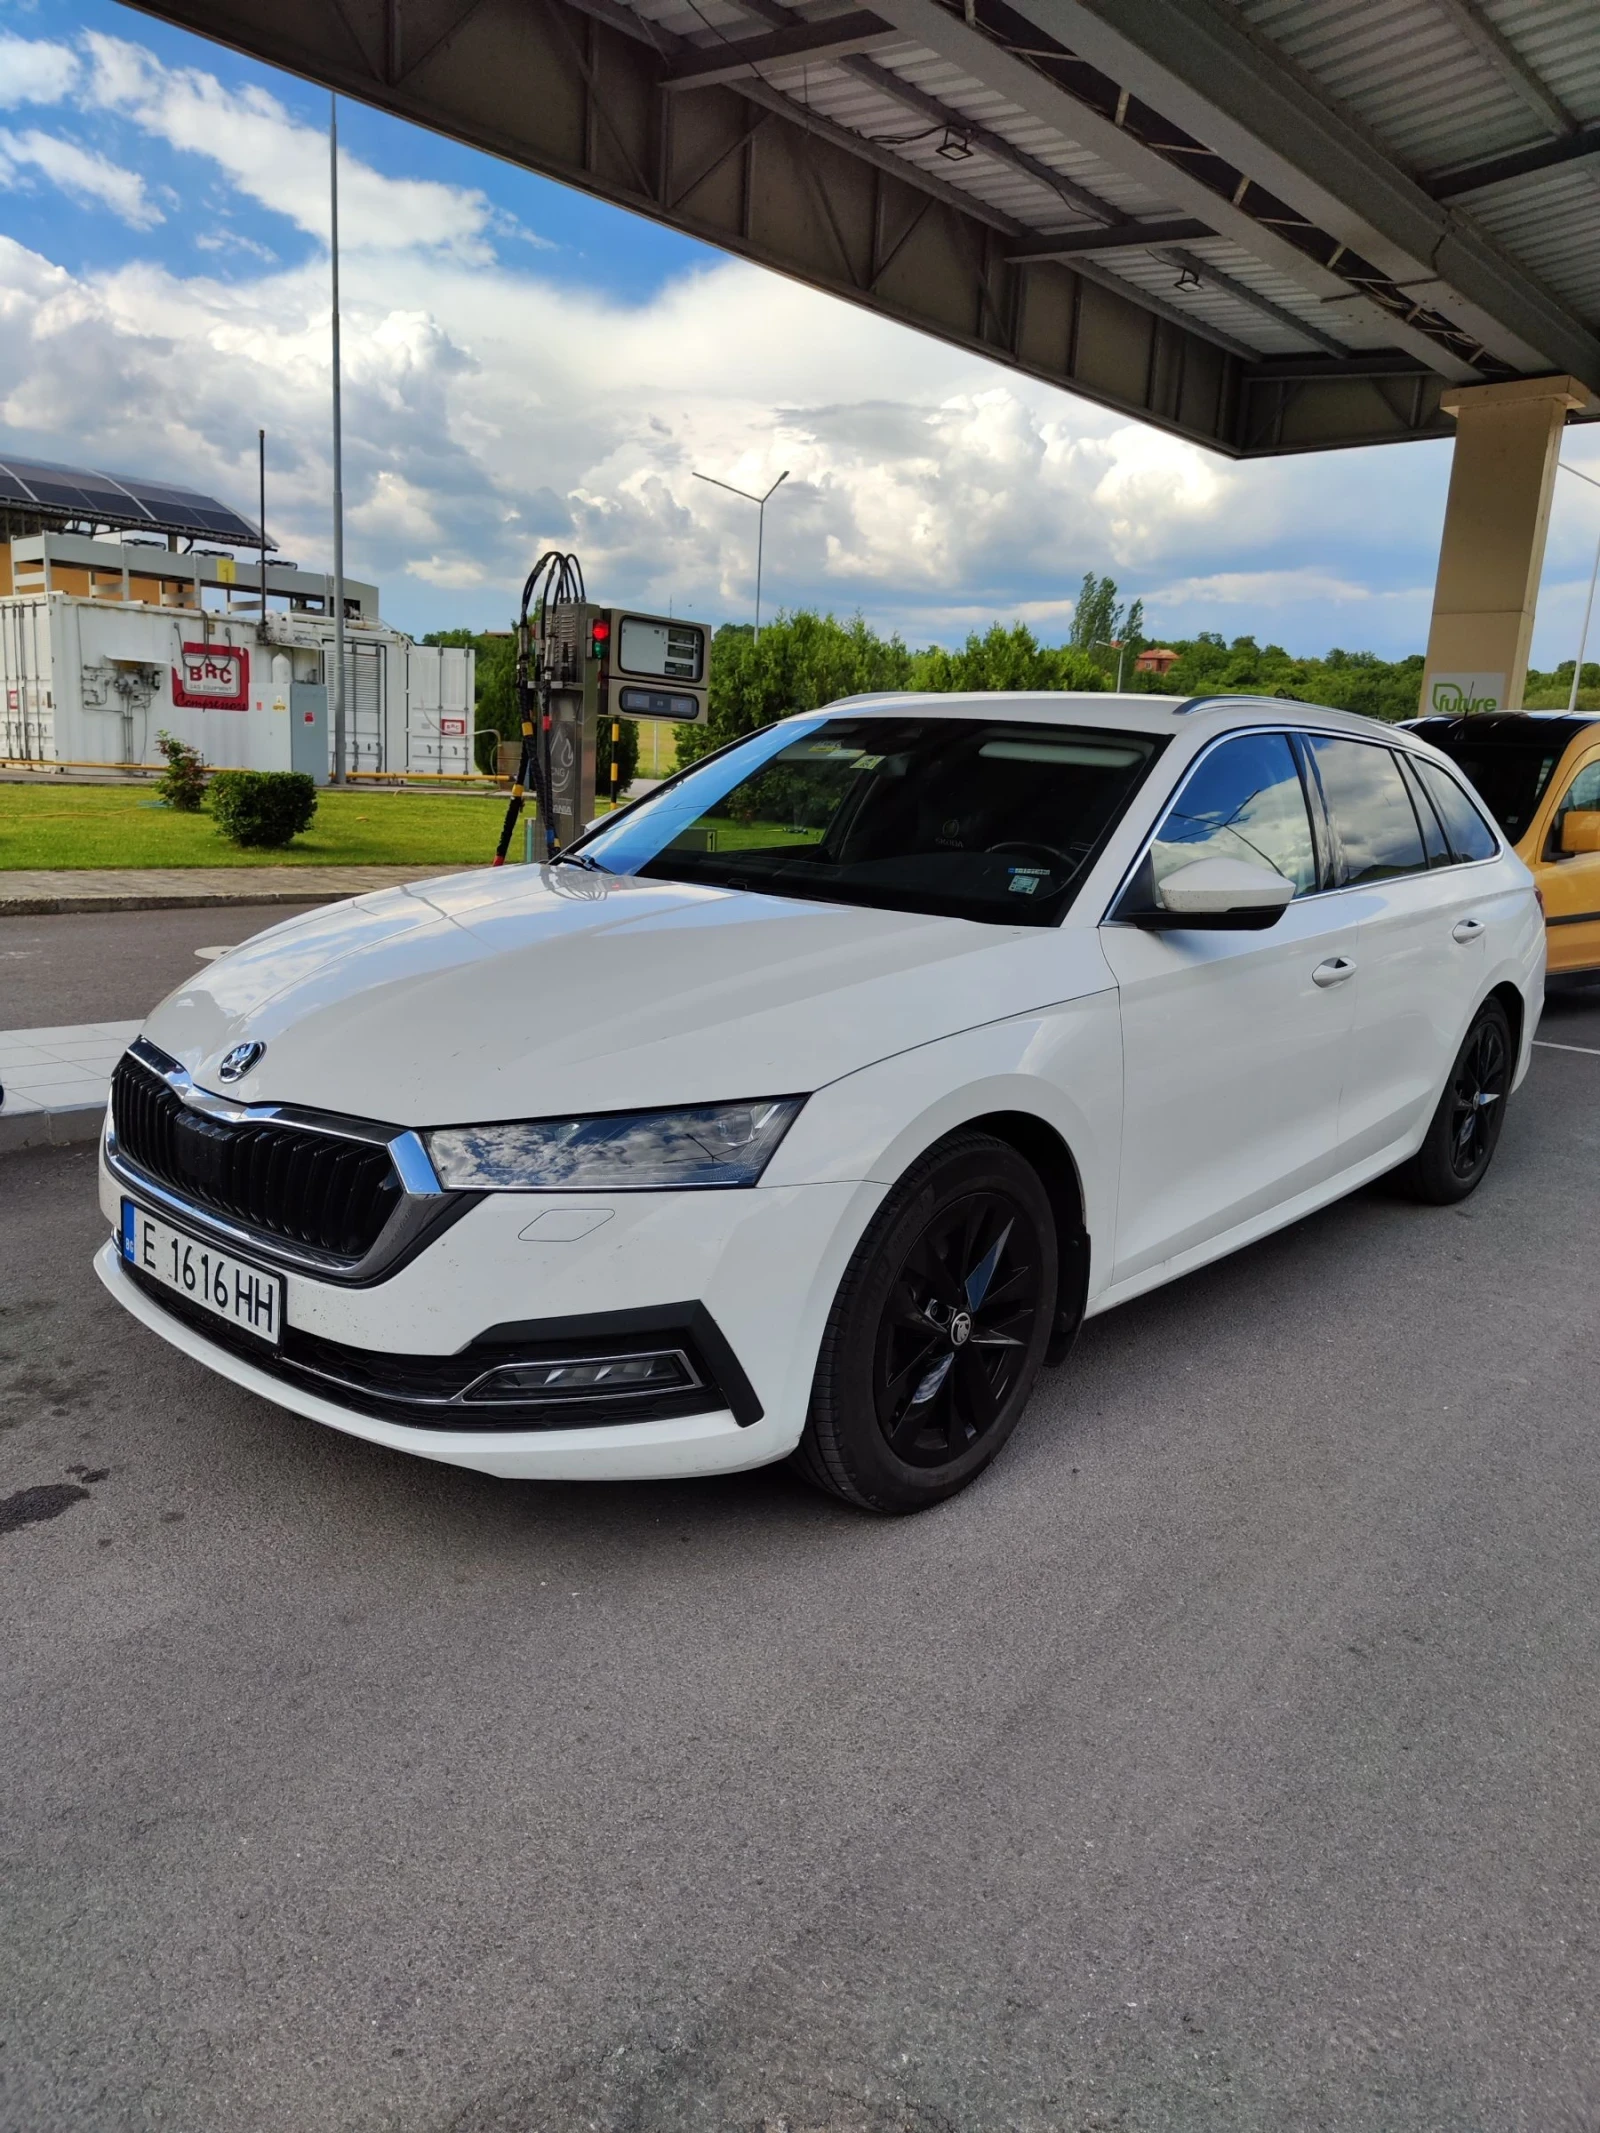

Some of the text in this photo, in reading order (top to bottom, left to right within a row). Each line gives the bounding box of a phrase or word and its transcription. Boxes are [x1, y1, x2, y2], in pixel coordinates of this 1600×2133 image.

[189, 663, 232, 684] BRC
[1437, 690, 1497, 712] future
[125, 1237, 134, 1253] BG
